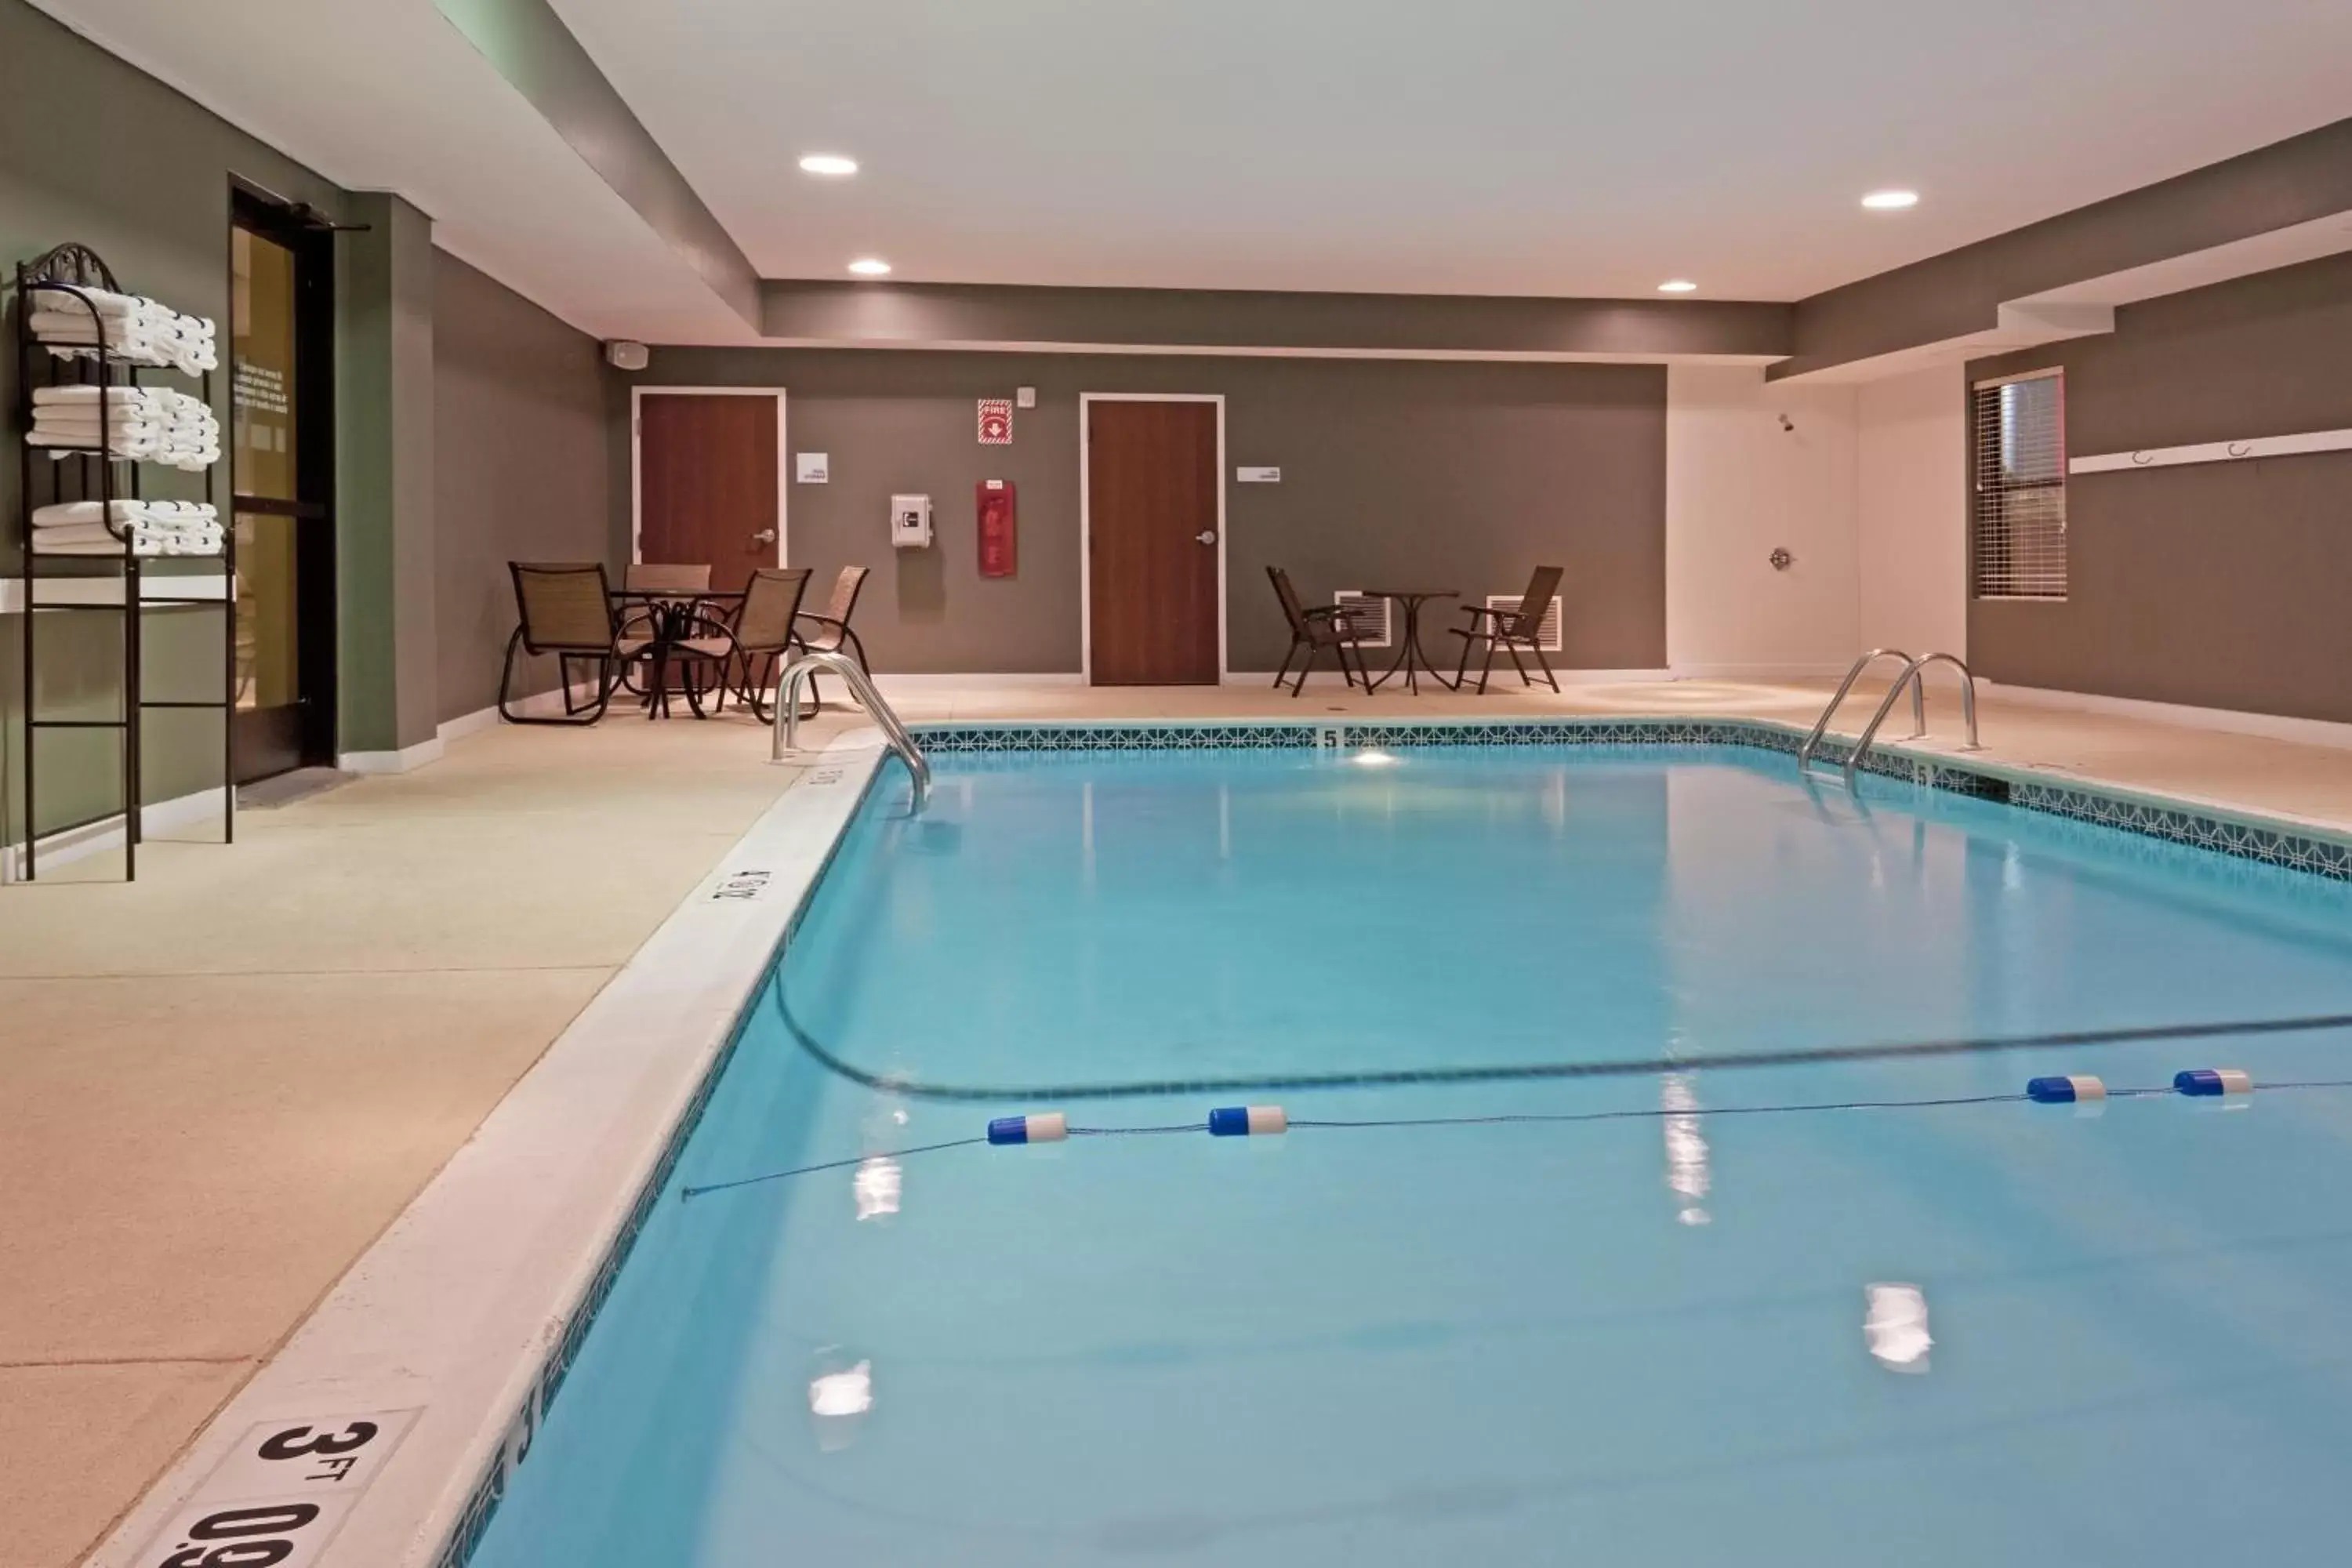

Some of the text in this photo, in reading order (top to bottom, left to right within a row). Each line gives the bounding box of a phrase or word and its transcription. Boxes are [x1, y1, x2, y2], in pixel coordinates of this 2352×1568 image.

[983, 405, 1006, 415] FIRE
[1324, 730, 1337, 747] 5
[258, 1421, 379, 1461] 3
[305, 1456, 356, 1482] FT
